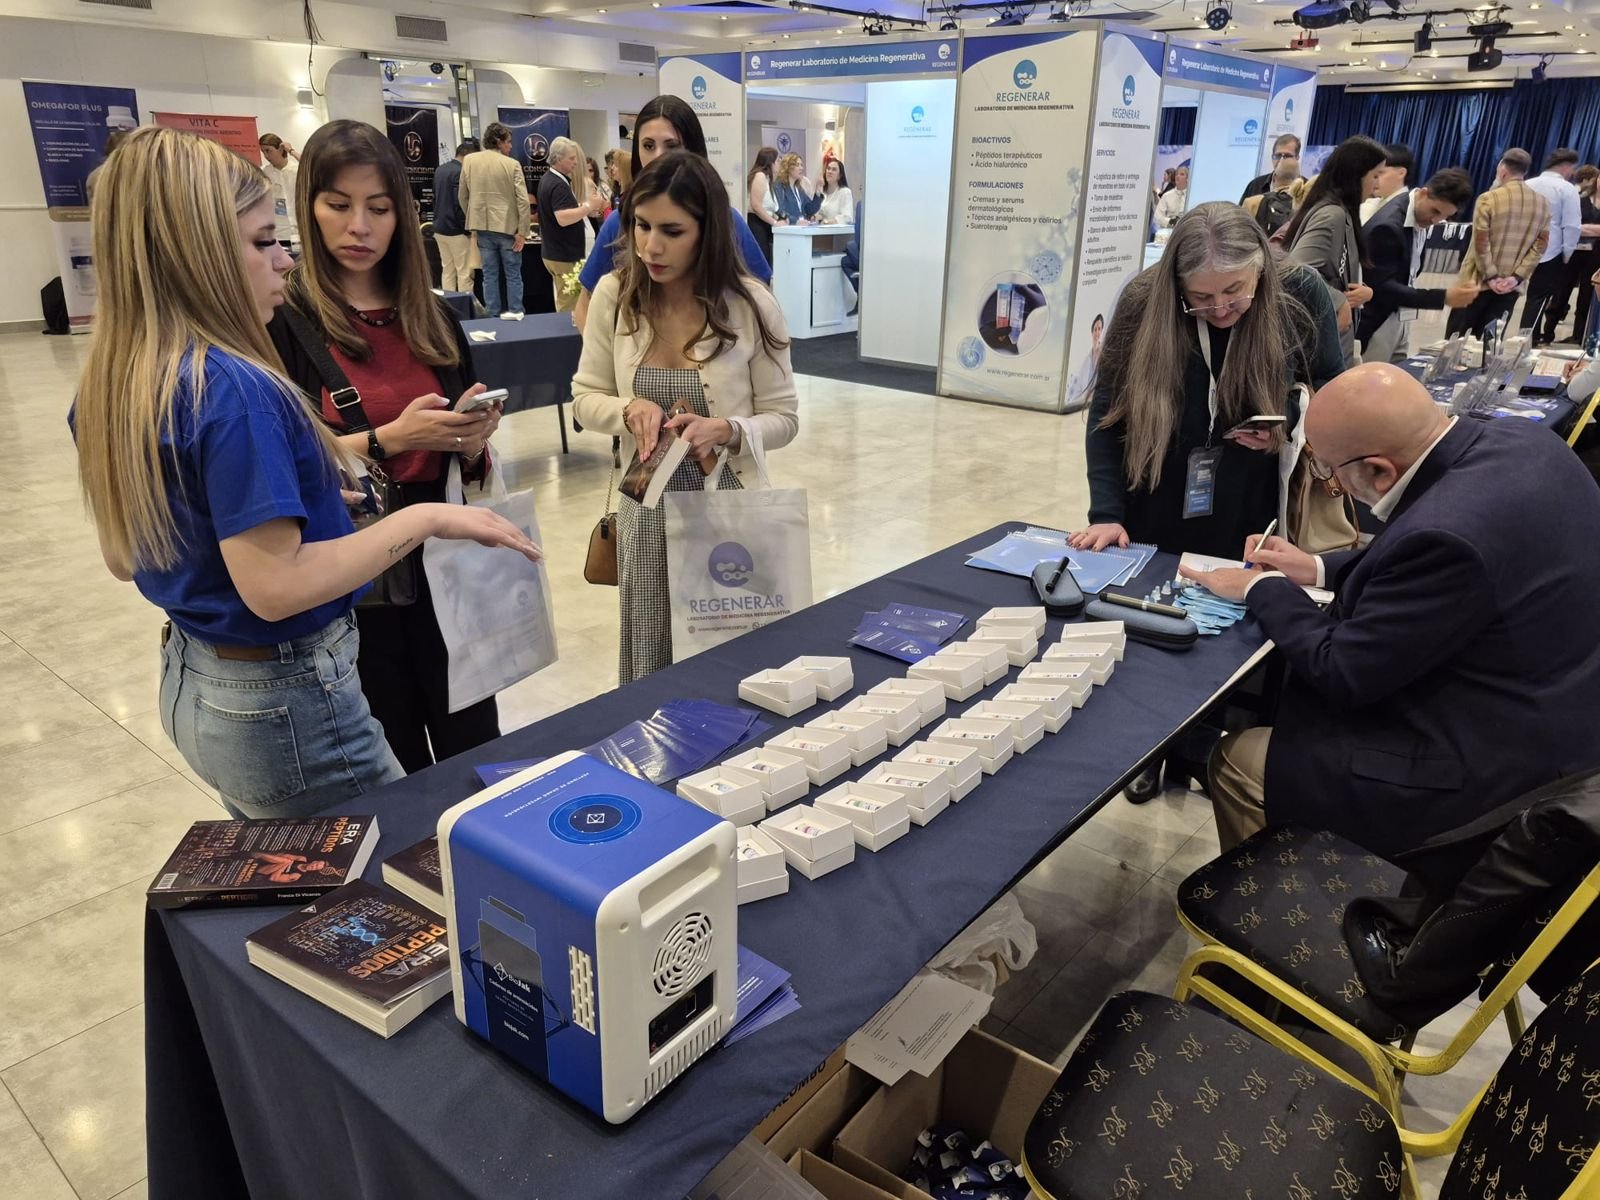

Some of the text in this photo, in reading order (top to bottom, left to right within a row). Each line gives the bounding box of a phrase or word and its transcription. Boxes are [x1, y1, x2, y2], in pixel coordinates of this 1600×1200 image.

[770, 60, 802, 69] Regenerar
[802, 57, 838, 66] Laboratorio
[849, 55, 879, 64] Medicina
[879, 52, 926, 63] Regenerativa
[996, 91, 1050, 102] REGENERAR
[31, 101, 102, 112] OMEGAFOR PLUS
[1112, 107, 1141, 120] REGENERAR
[189, 118, 211, 127] VITA
[975, 151, 1042, 160] Péptidos terapéuticos
[974, 160, 992, 168] Ácido
[969, 181, 1024, 189] FORMULACIONES
[972, 195, 995, 203] Cremas
[968, 205, 1014, 214] dermatológicos
[971, 213, 994, 221] Tópicos
[995, 215, 1031, 224] analgésicos
[1038, 216, 1062, 224] colirios
[970, 222, 1008, 231] Sueroterapia
[689, 594, 785, 613] REGENERAR
[320, 816, 350, 854] PÉPTIDOS
[340, 823, 361, 845] ERA
[348, 923, 447, 980] PÉPTIDOS
[382, 942, 449, 977] ERA
